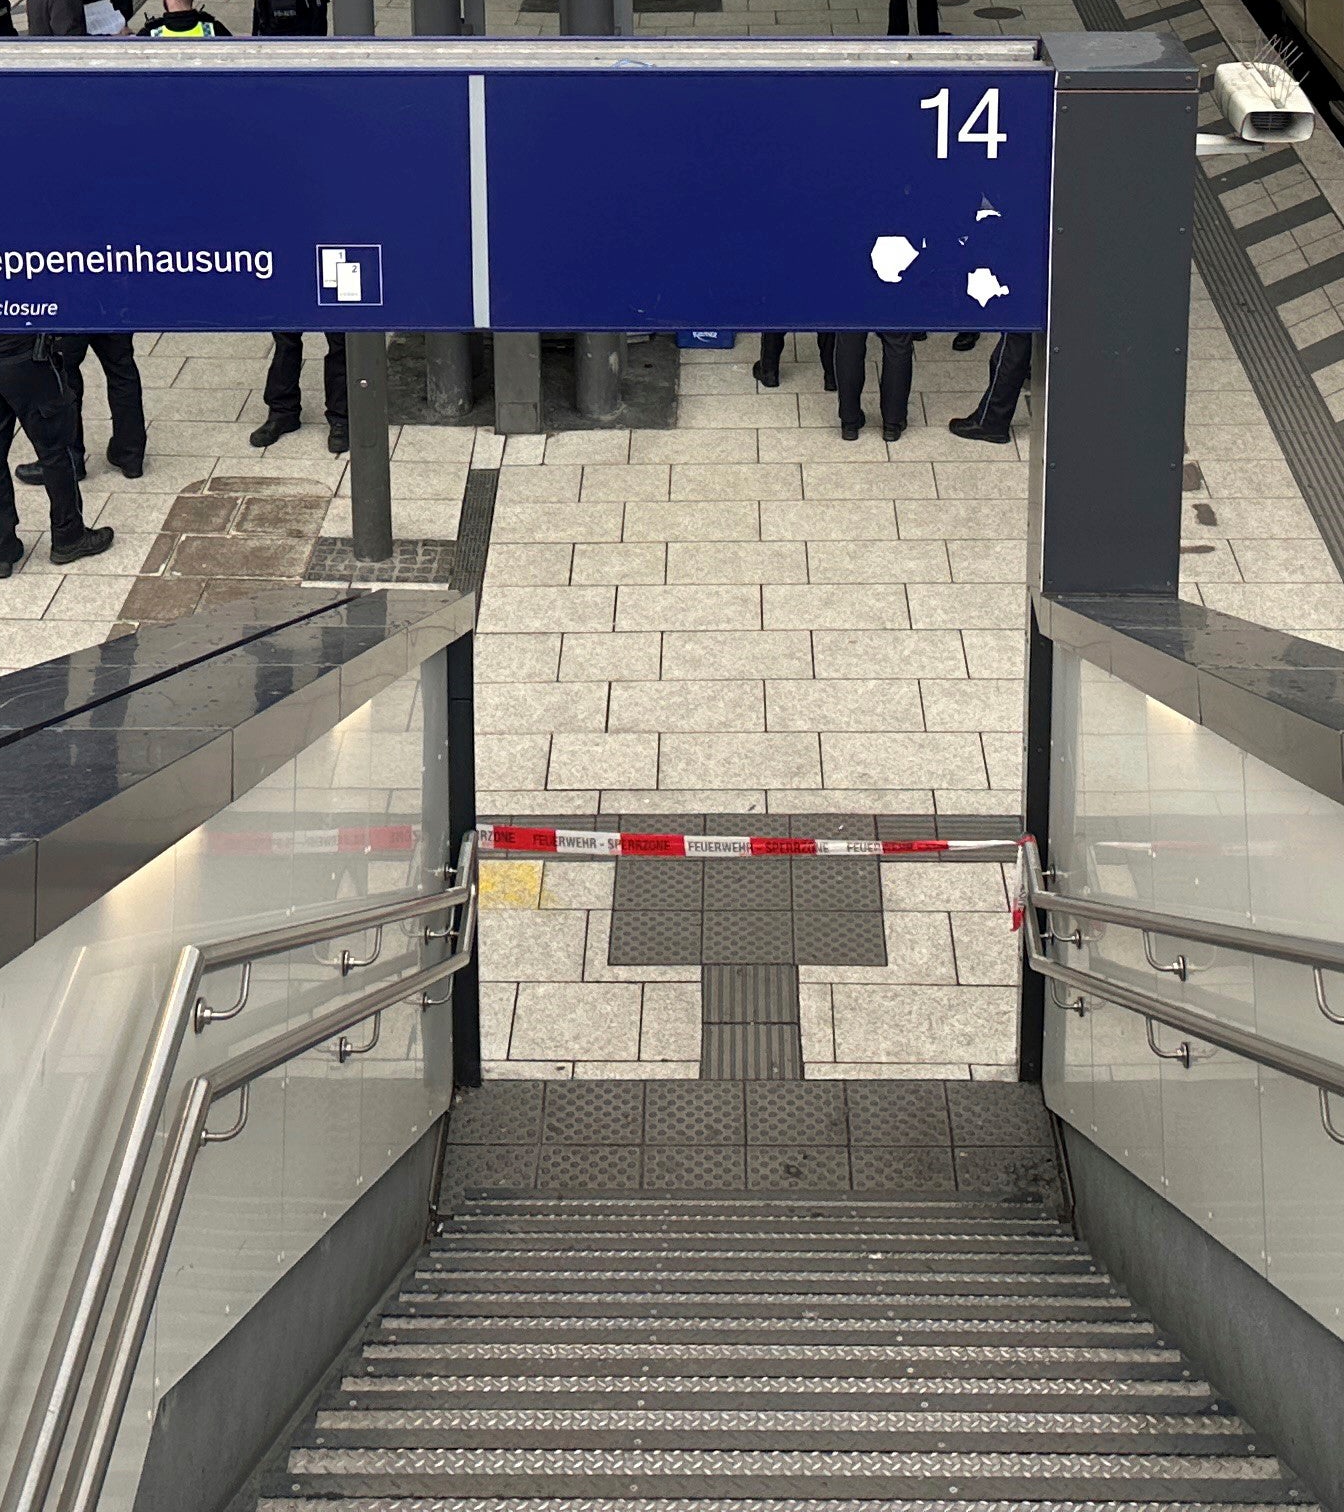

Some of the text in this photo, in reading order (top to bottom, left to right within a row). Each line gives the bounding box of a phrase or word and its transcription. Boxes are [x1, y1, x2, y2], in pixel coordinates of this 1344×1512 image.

[920, 87, 1008, 159] 14
[532, 834, 597, 849] FEUERWEHR
[607, 838, 671, 852] SPERRZONE
[688, 841, 752, 853] FEUERWEHR
[765, 841, 830, 854] SPERRZONE
